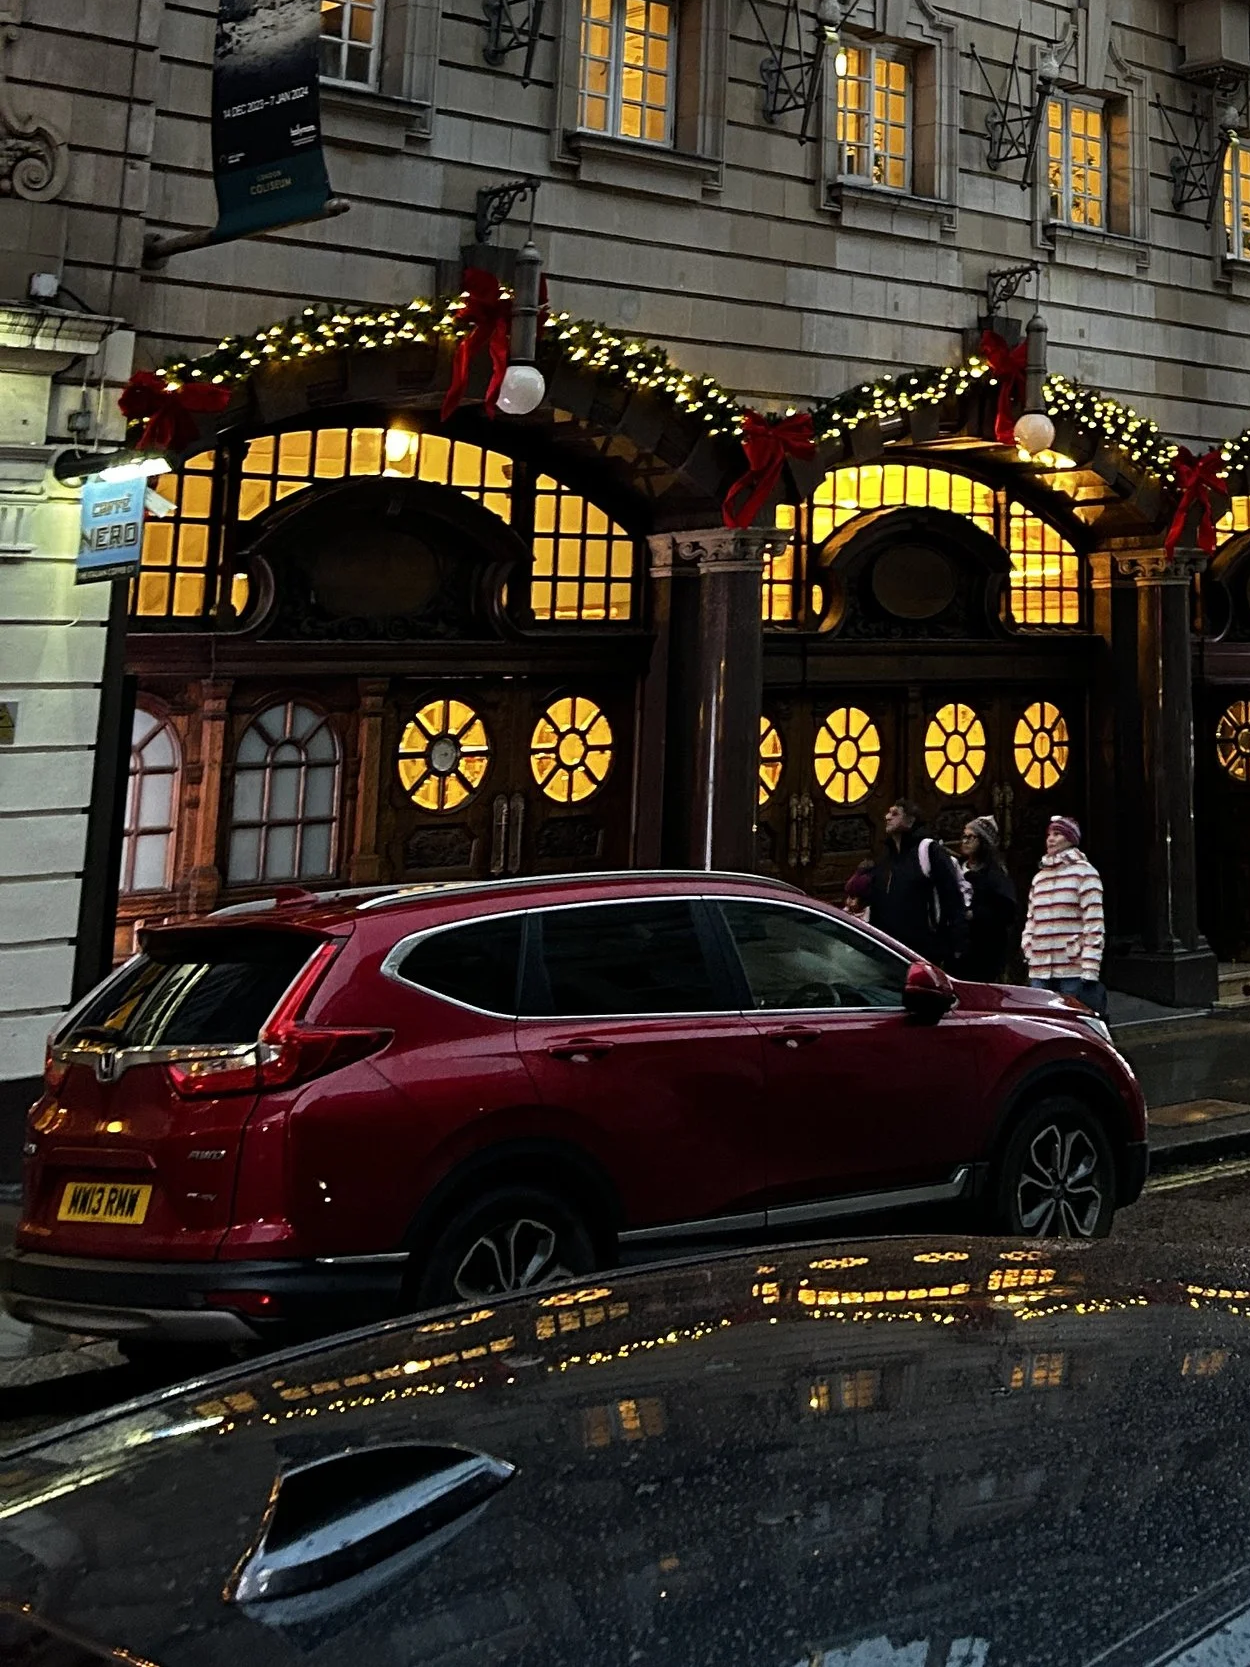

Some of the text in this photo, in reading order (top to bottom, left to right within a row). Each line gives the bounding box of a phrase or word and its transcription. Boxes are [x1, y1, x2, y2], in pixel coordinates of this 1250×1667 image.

[231, 104, 246, 117] DEC
[247, 99, 264, 112] 2023
[275, 91, 290, 104] JAN
[291, 86, 309, 100] 2024
[250, 178, 292, 195] COLISEUM
[80, 522, 138, 553] NERO
